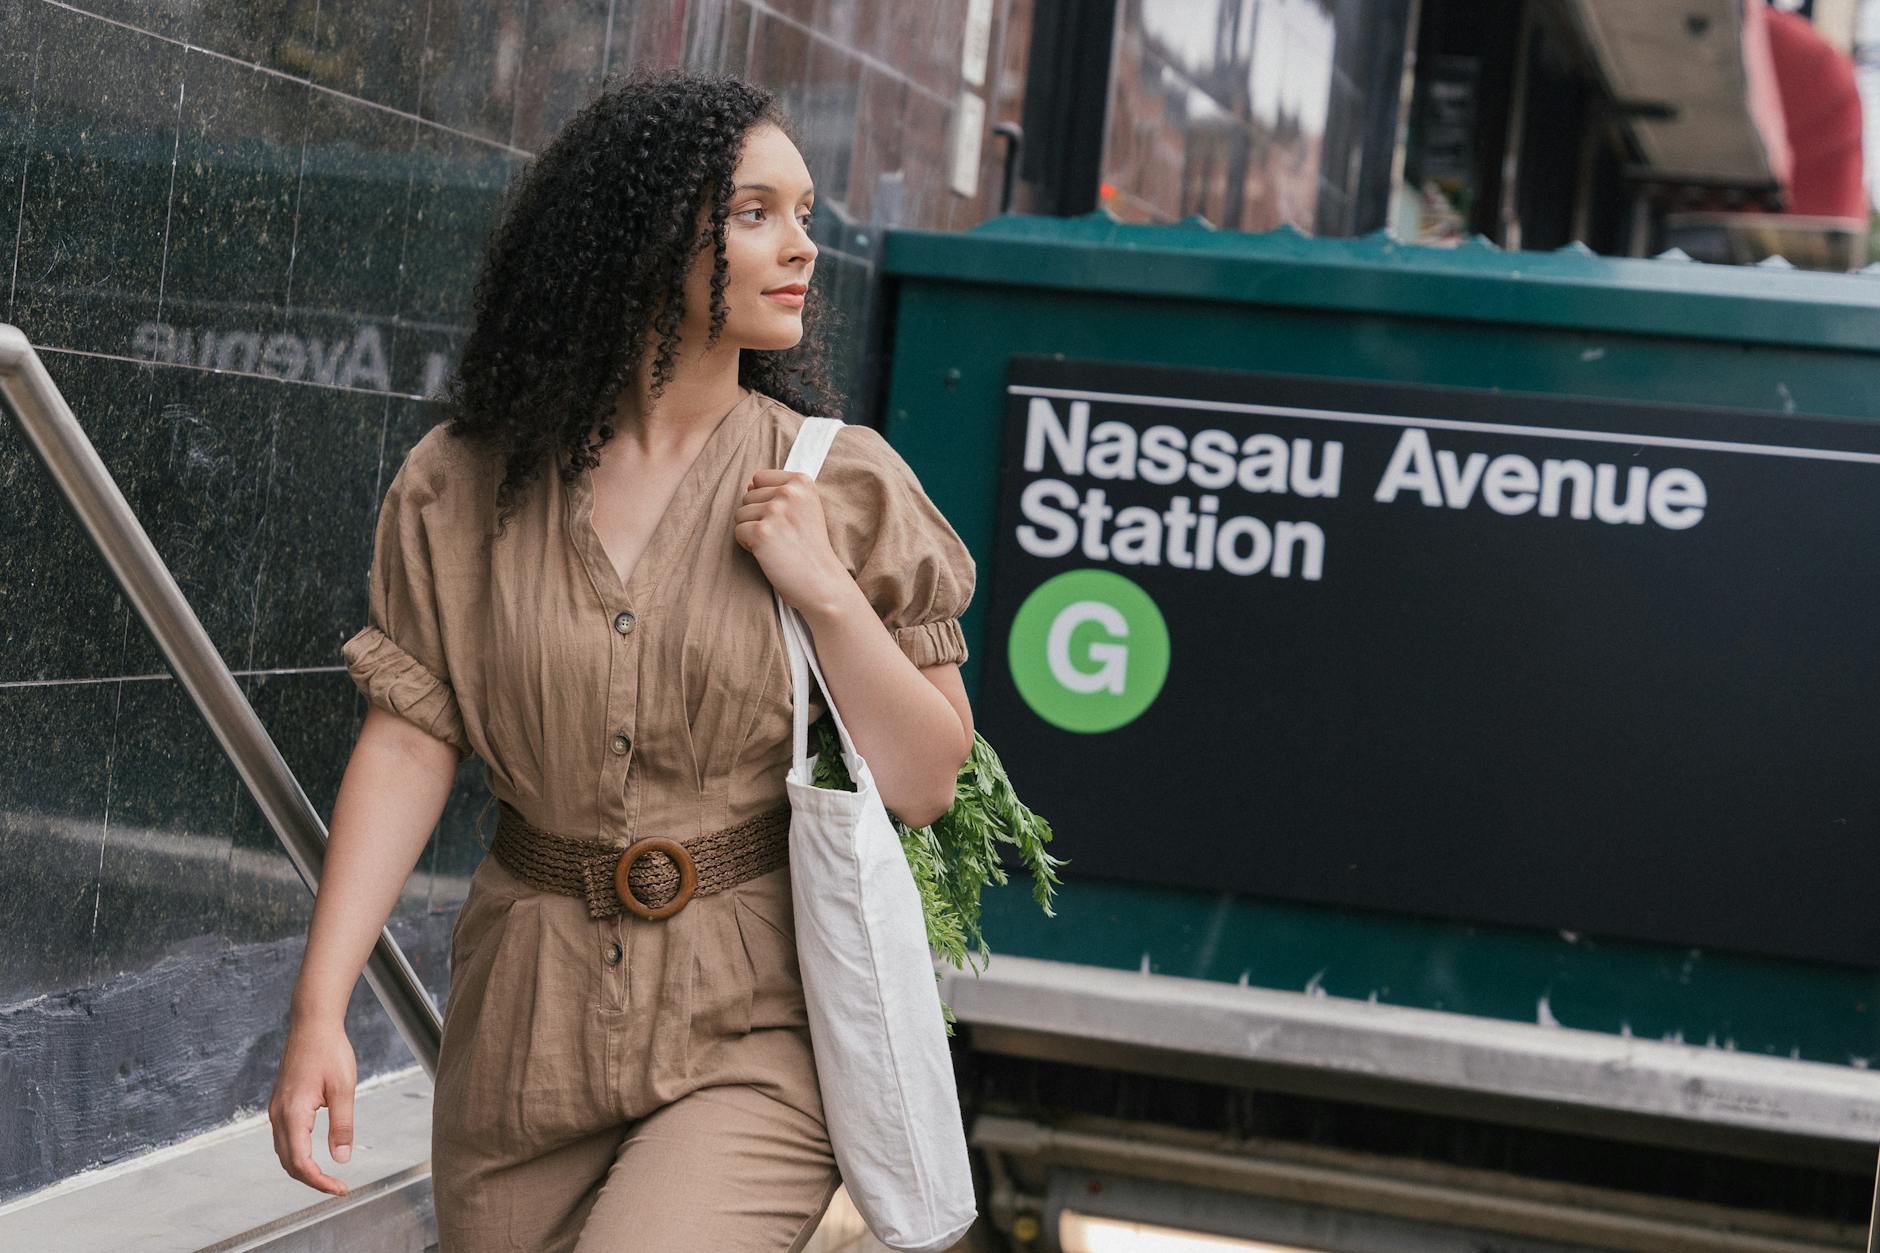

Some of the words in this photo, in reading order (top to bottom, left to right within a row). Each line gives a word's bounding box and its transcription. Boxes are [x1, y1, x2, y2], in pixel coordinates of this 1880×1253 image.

[1022, 396, 1344, 499] Nassau
[1373, 427, 1708, 531] Avenue
[1015, 477, 1326, 582] Station
[1045, 599, 1130, 696] G
